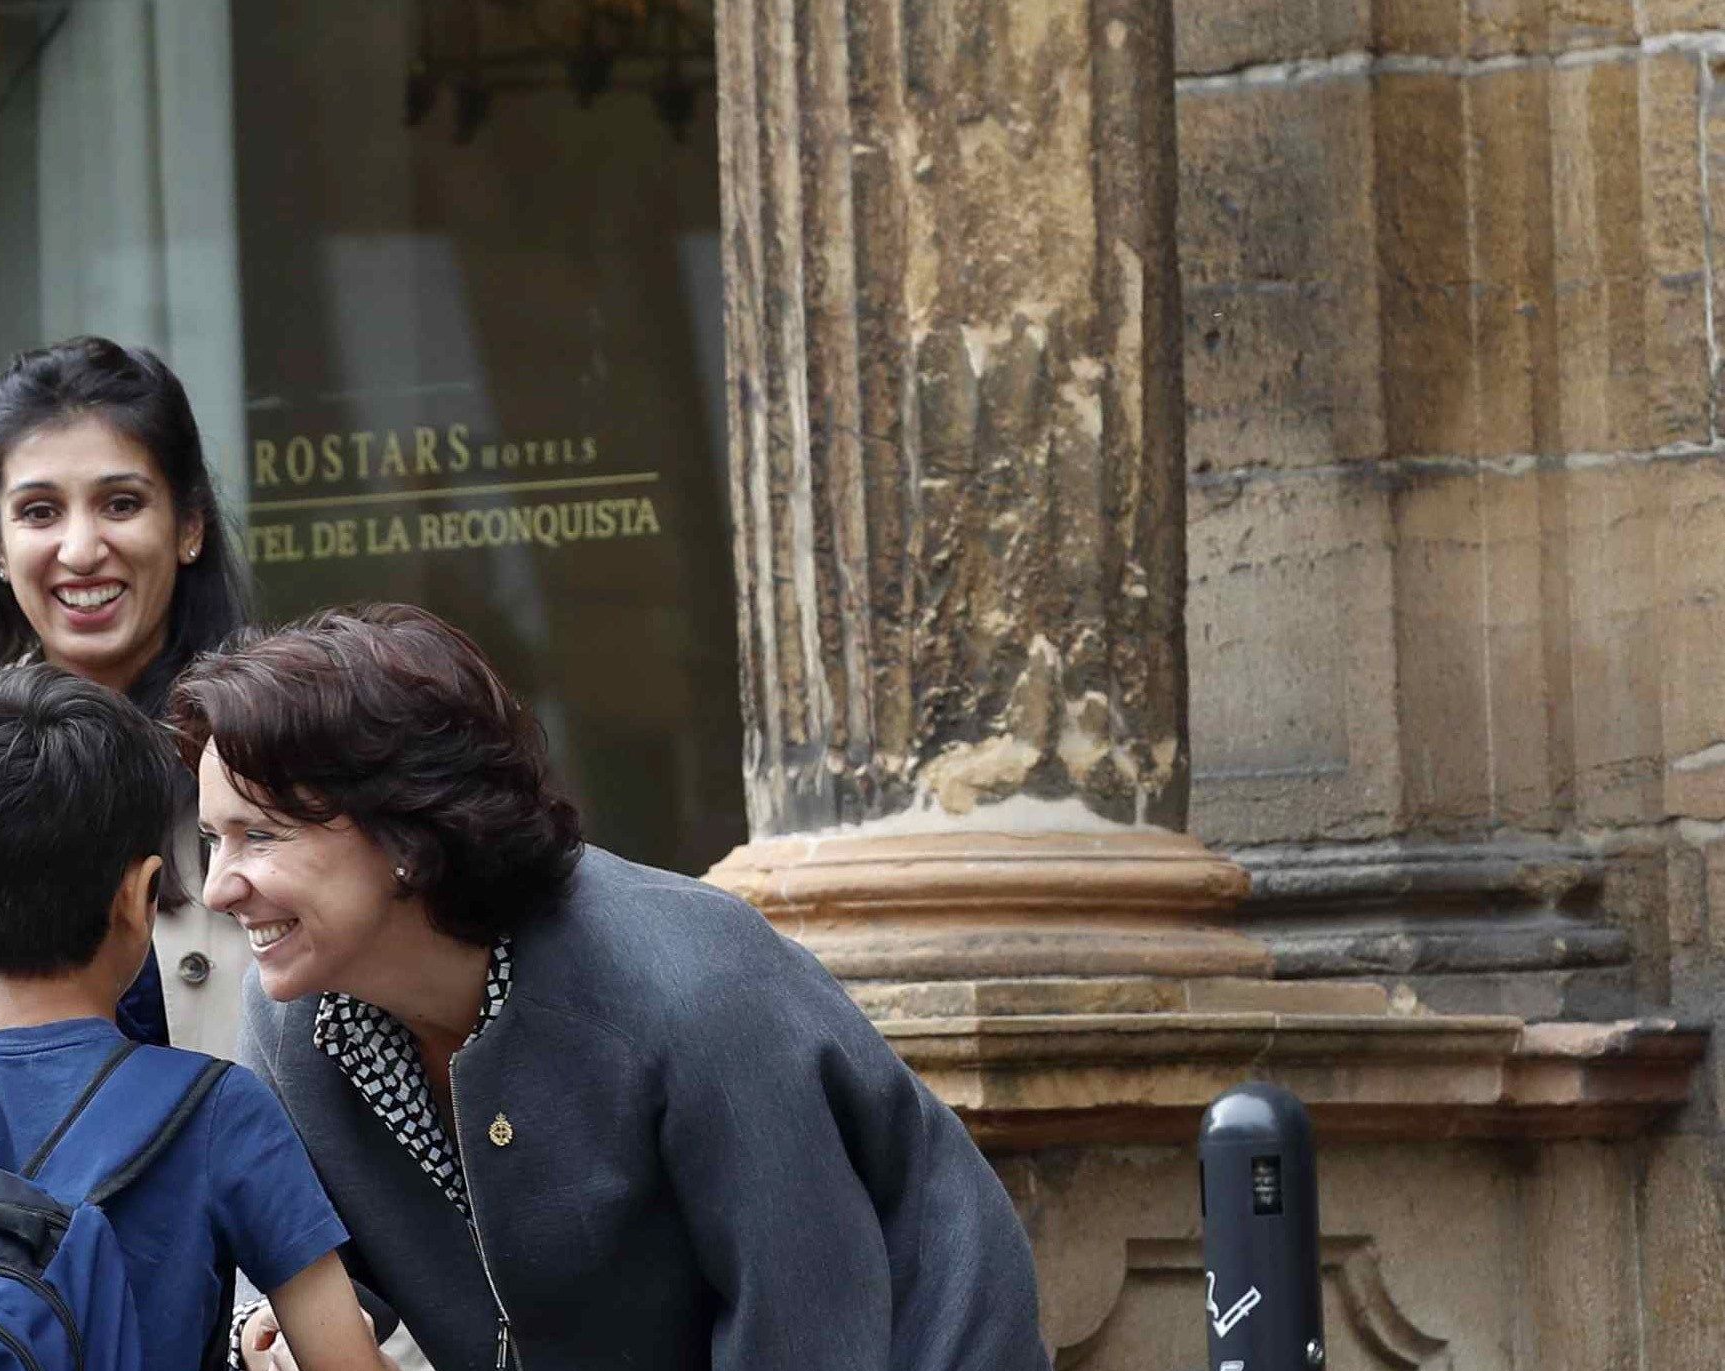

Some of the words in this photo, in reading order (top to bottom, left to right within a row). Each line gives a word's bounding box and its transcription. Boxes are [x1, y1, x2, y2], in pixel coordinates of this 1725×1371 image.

[220, 423, 471, 486] ROSTARS
[236, 524, 304, 563] TEL
[311, 519, 358, 560] DE
[365, 516, 412, 555] LA
[419, 497, 661, 551] RECONQUISTA
